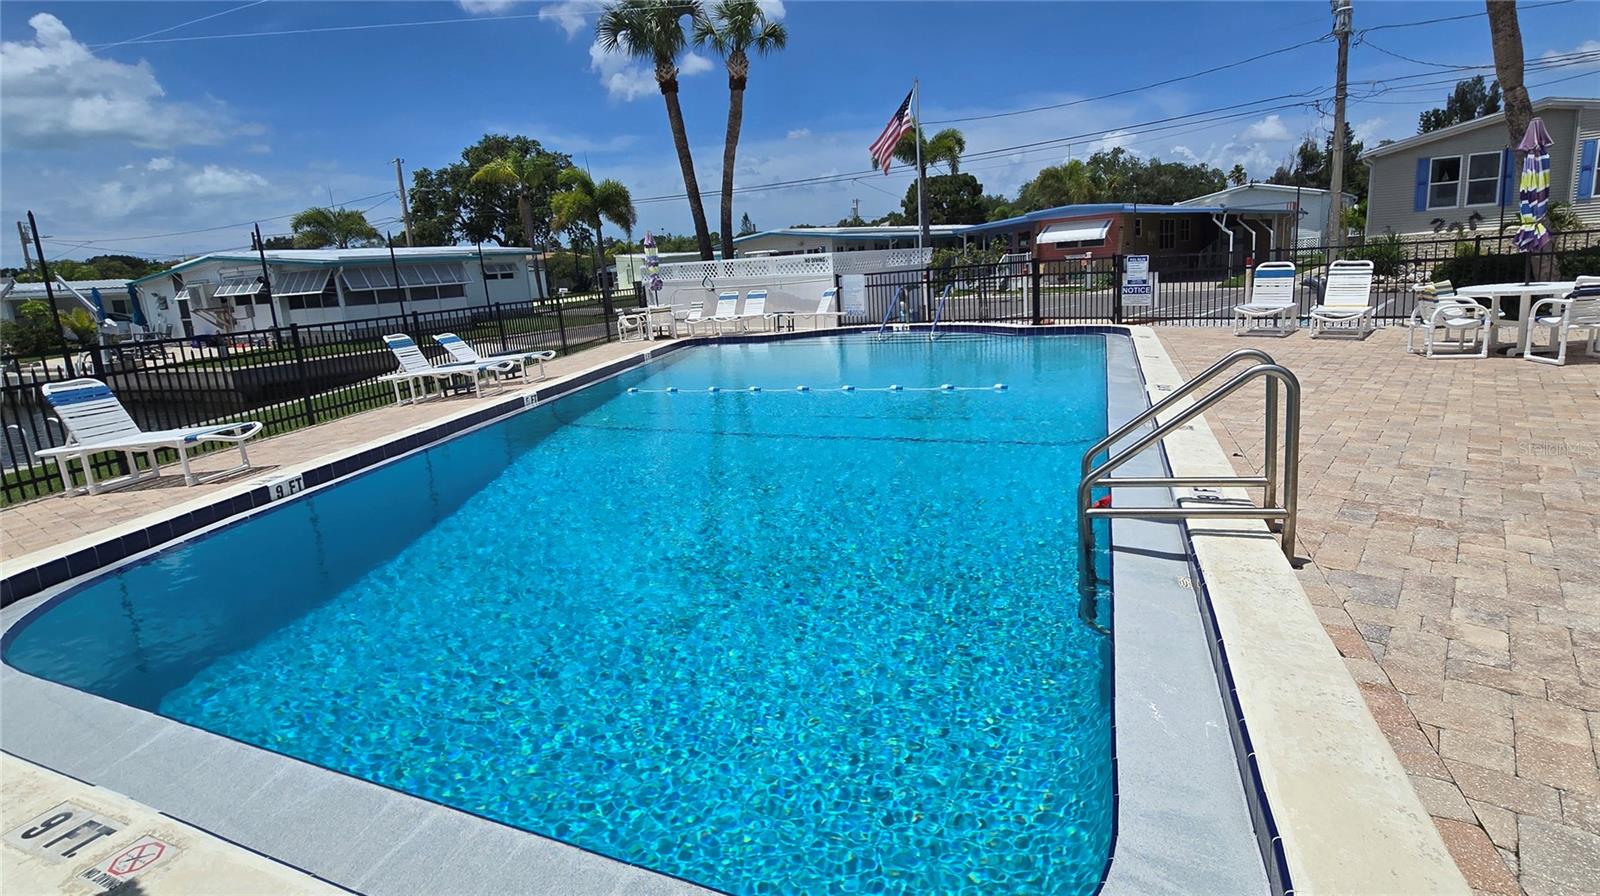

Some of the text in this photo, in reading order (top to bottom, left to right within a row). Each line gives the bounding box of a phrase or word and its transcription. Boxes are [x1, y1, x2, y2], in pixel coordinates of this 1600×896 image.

[1122, 286, 1151, 294] NOTICE
[275, 477, 303, 499] 9 FT
[20, 811, 74, 840] 9
[80, 867, 102, 879] NO
